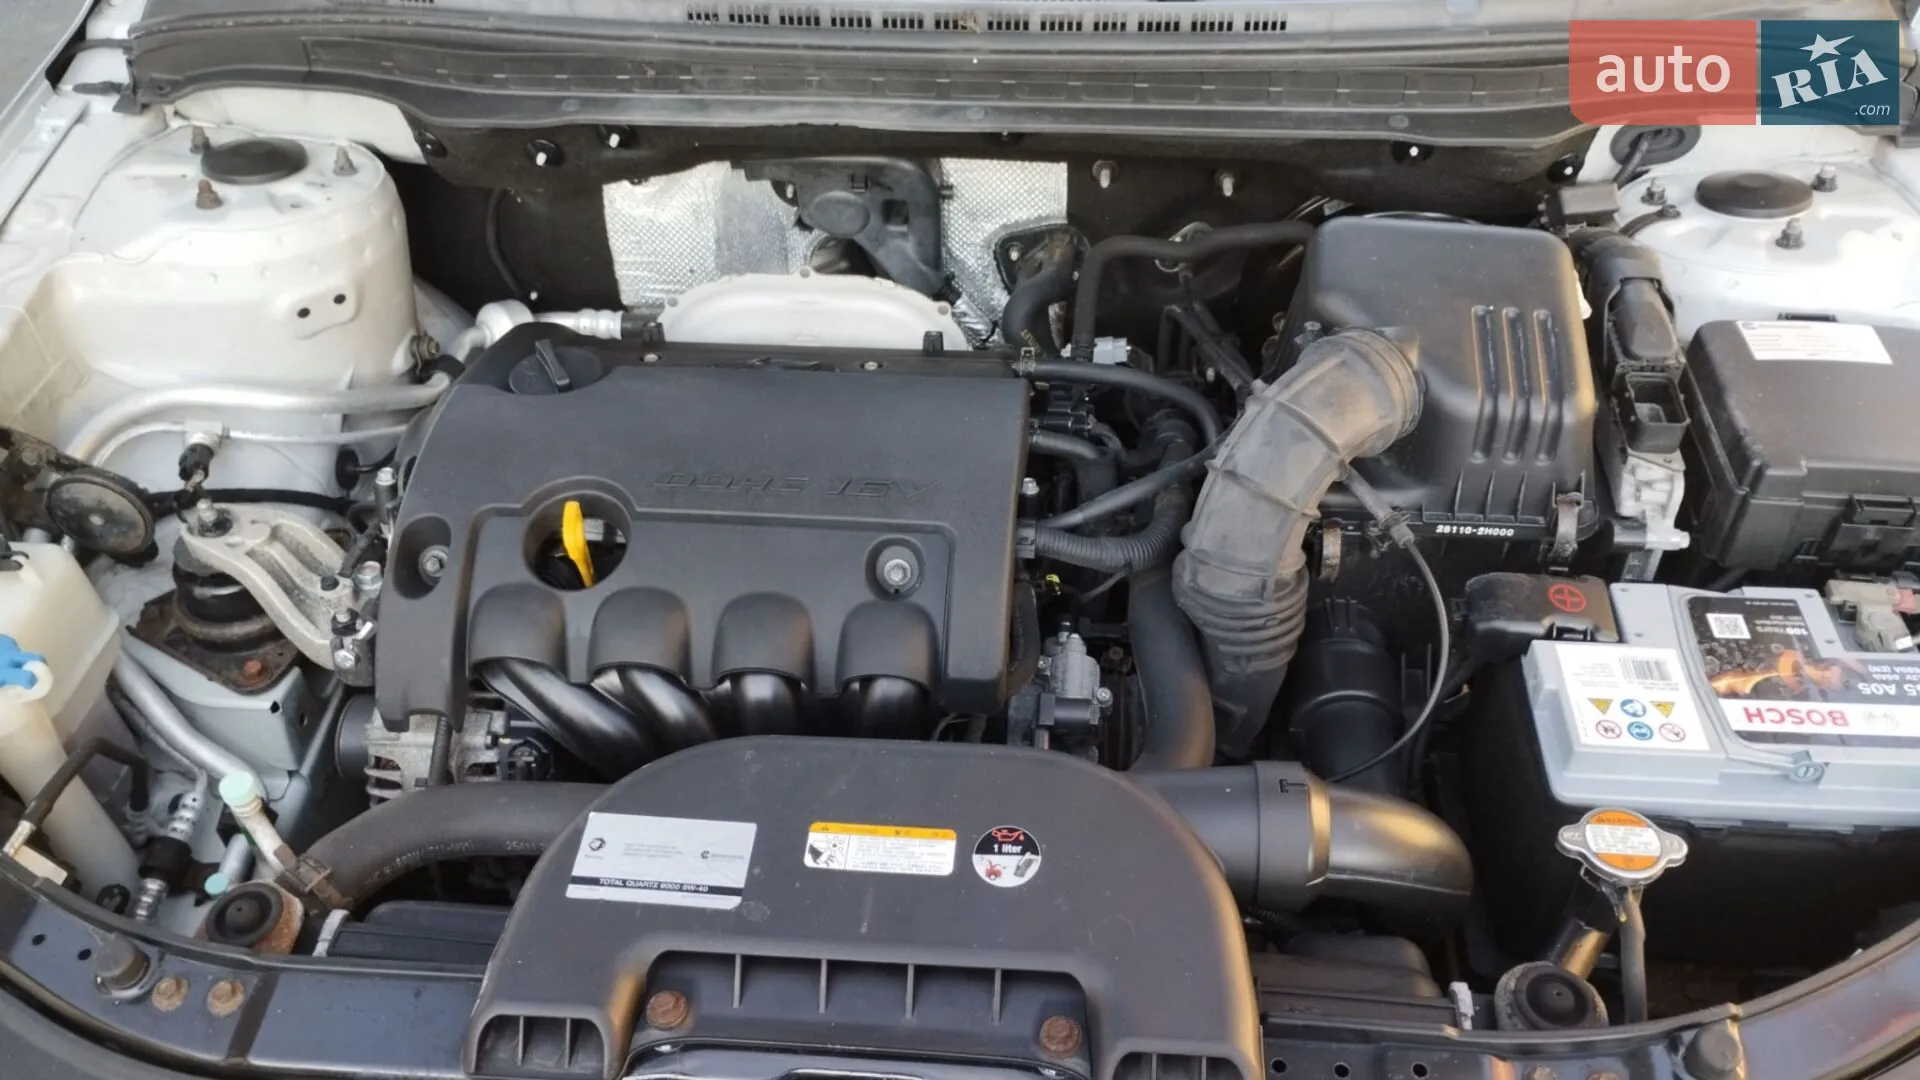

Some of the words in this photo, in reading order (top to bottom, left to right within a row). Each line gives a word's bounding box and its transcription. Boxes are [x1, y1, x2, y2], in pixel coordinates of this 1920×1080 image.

[653, 472, 809, 492] DOHC
[826, 478, 944, 500] 16V
[1857, 682, 1896, 696] A05
[1743, 706, 1849, 727] BOSCH
[993, 843, 999, 853] 1
[1001, 843, 1023, 854] liter
[599, 878, 625, 887] TOTAL
[626, 880, 659, 889] QUARTZ
[682, 884, 709, 893] 5W-40
